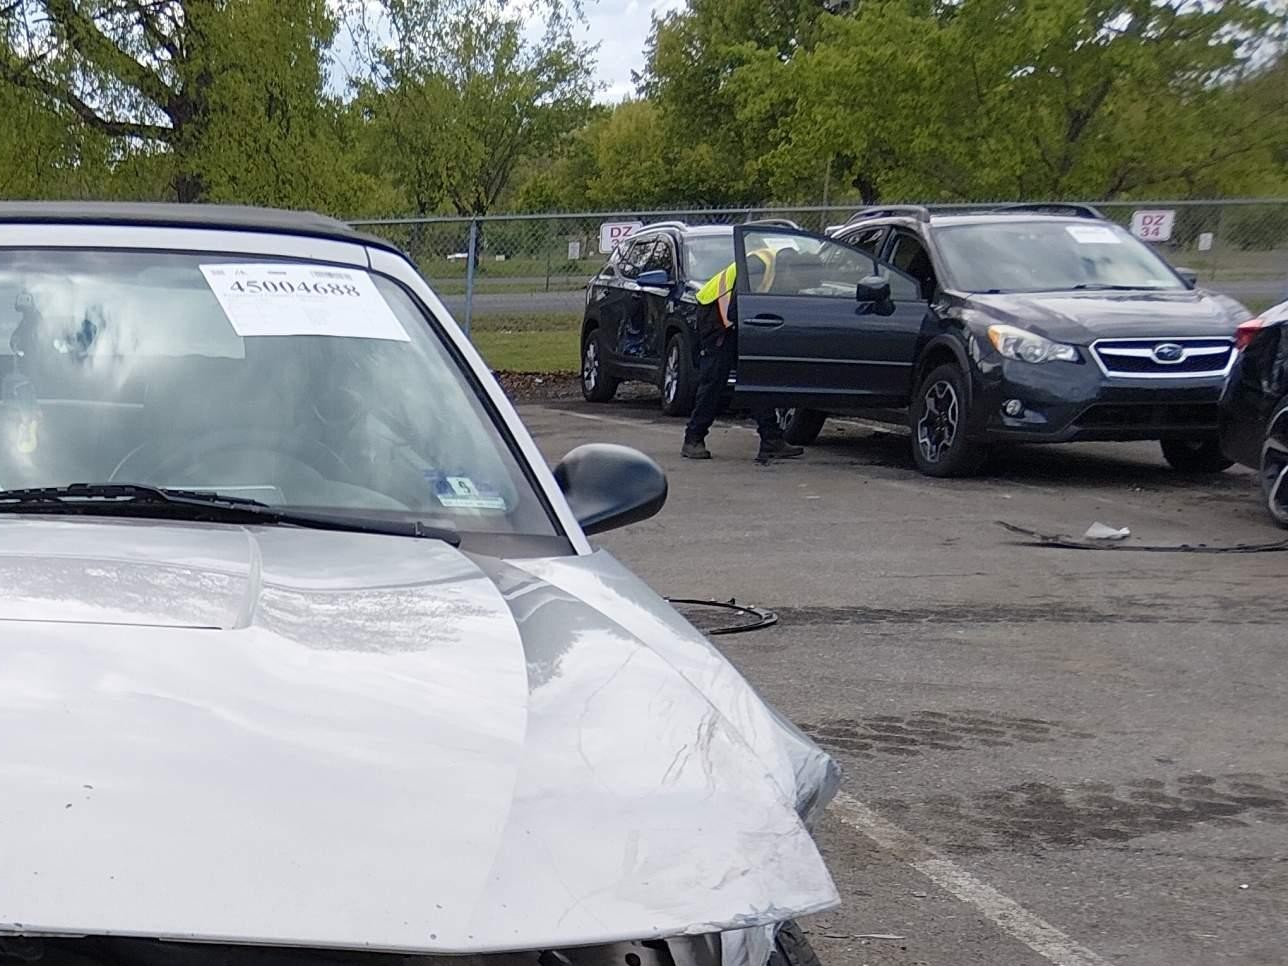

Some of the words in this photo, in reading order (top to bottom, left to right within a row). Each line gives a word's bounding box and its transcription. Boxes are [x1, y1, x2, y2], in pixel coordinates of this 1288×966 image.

[1142, 215, 1166, 226] DZ
[610, 226, 633, 238] DZ
[230, 280, 361, 297] 45004688
